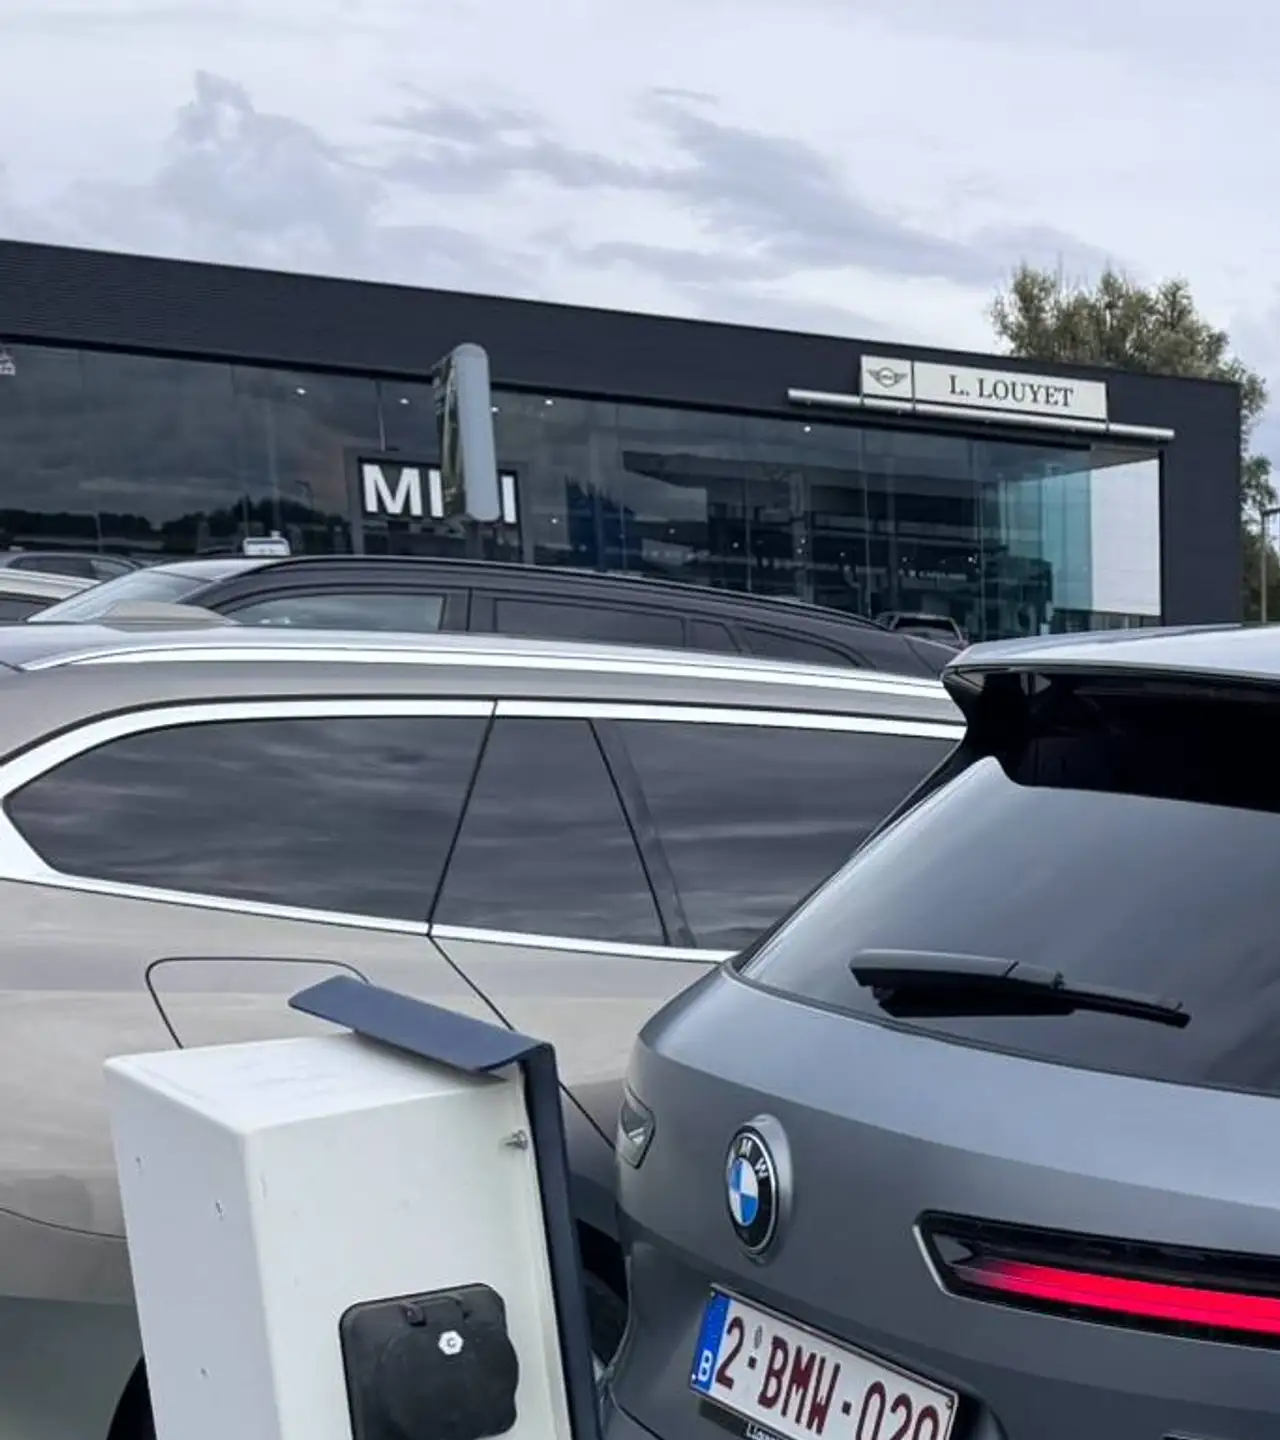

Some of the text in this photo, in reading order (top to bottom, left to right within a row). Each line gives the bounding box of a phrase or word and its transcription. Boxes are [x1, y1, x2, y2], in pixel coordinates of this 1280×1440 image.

[949, 374, 1074, 407] L. LOUYET
[362, 464, 517, 524] MII
[697, 1350, 713, 1382] B
